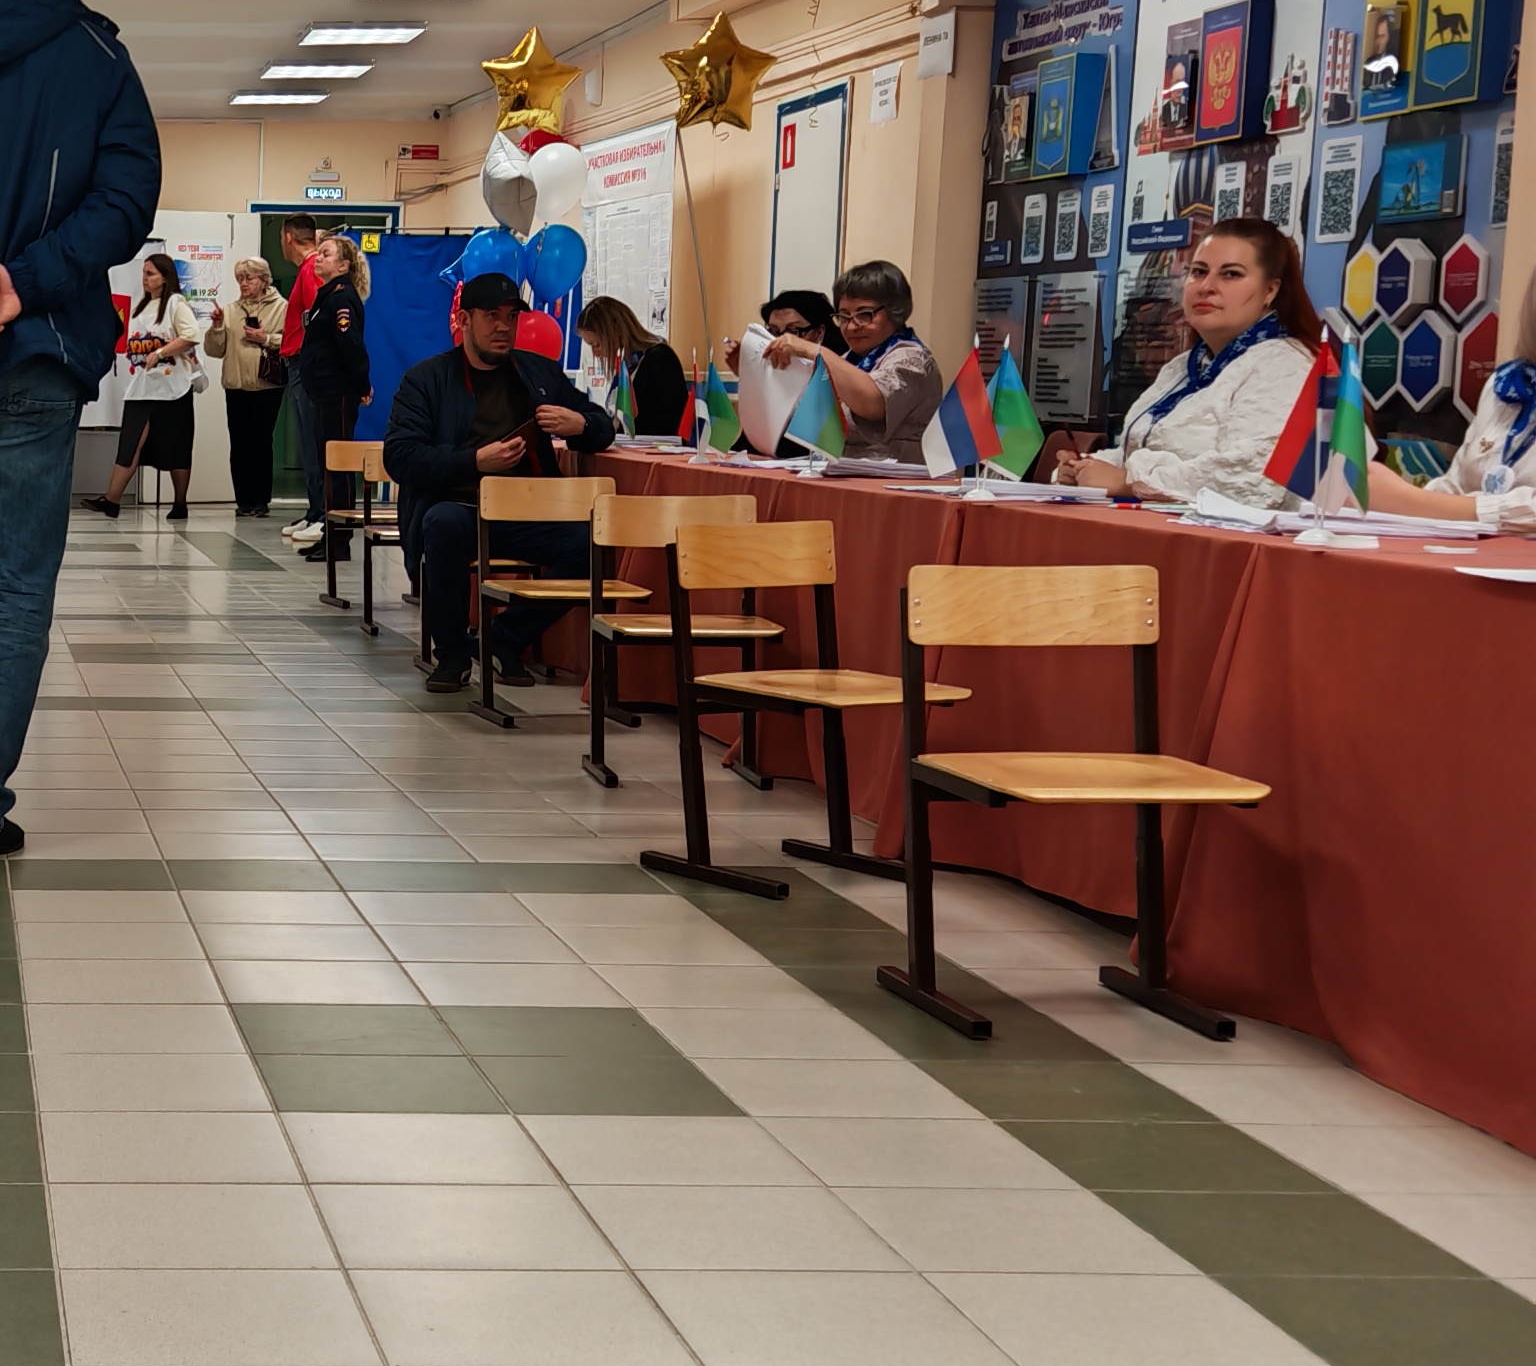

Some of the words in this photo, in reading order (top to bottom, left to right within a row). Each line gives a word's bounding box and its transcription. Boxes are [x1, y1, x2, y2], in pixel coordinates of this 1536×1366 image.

[588, 151, 619, 170] УЧАСТКОВАЯ
[619, 139, 666, 164] ИЗБИРАТЕЛЬНАЯ
[603, 170, 631, 189] КОМИССИЯ
[307, 188, 342, 199] ВЫХОД
